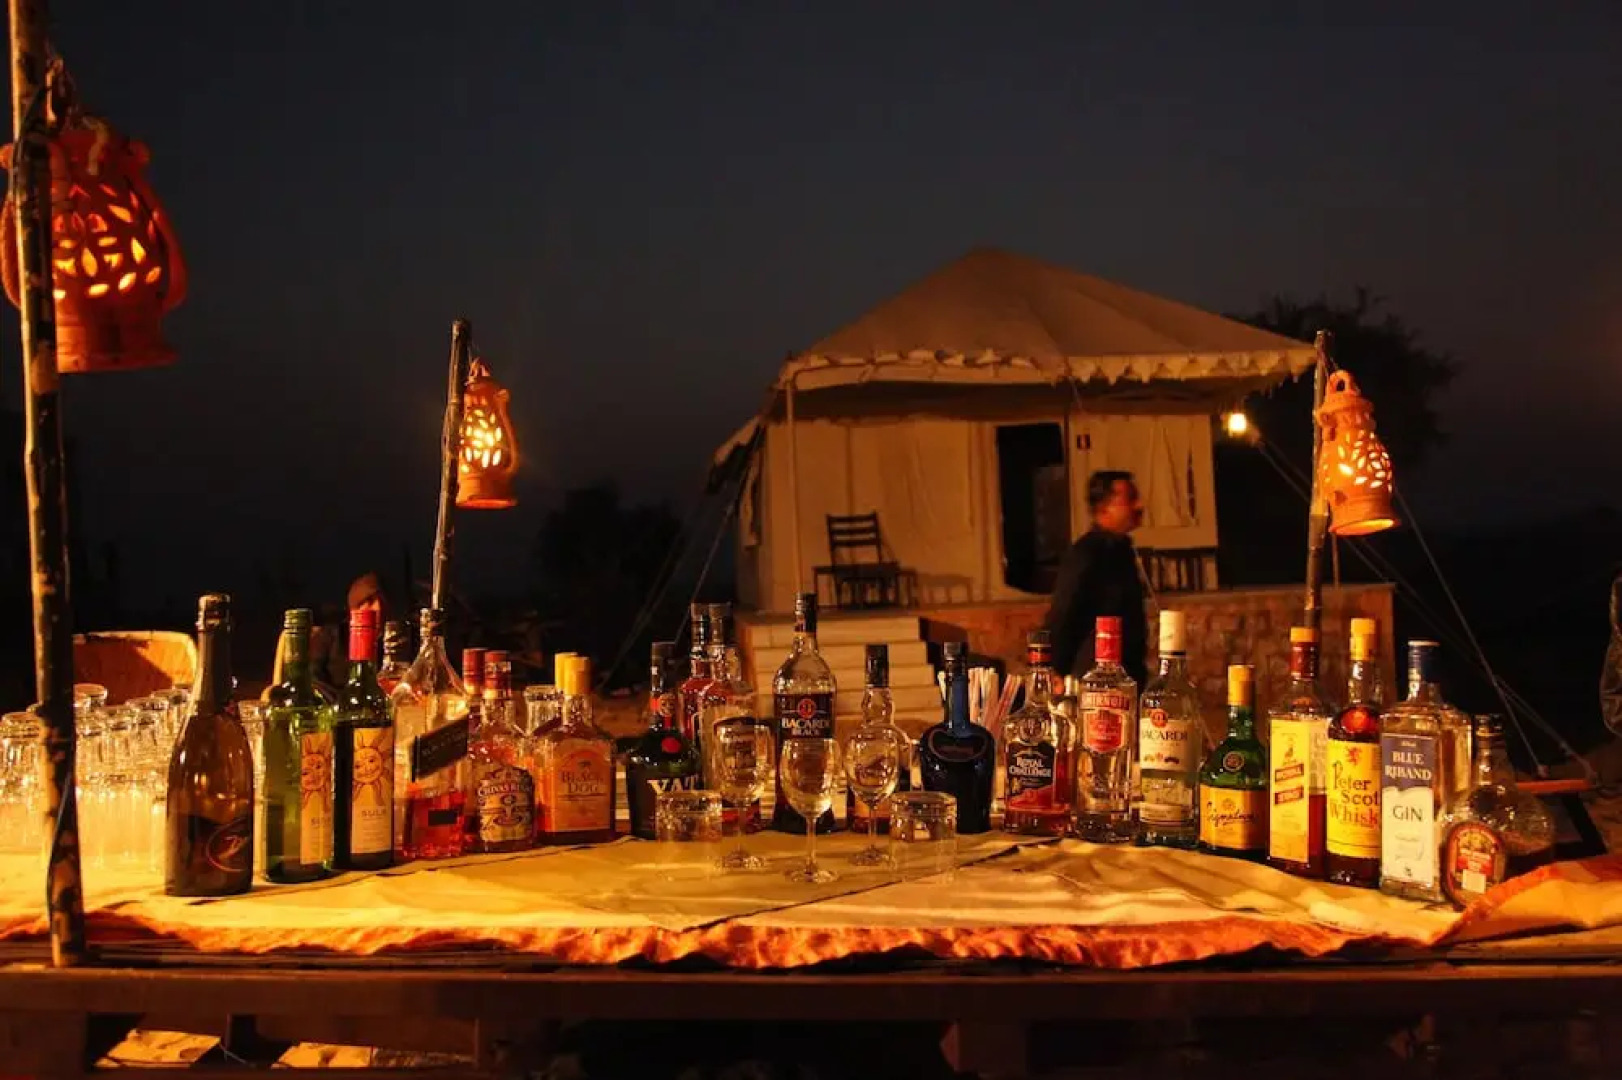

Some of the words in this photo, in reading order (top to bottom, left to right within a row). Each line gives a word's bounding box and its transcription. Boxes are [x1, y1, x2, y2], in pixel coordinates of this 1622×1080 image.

[781, 718, 831, 729] BACARDI
[1392, 751, 1424, 765] BLUE
[1332, 760, 1371, 790] Peter
[1385, 765, 1431, 780] RIBAND
[1329, 801, 1379, 825] Whisk
[1392, 806, 1423, 822] GIN
